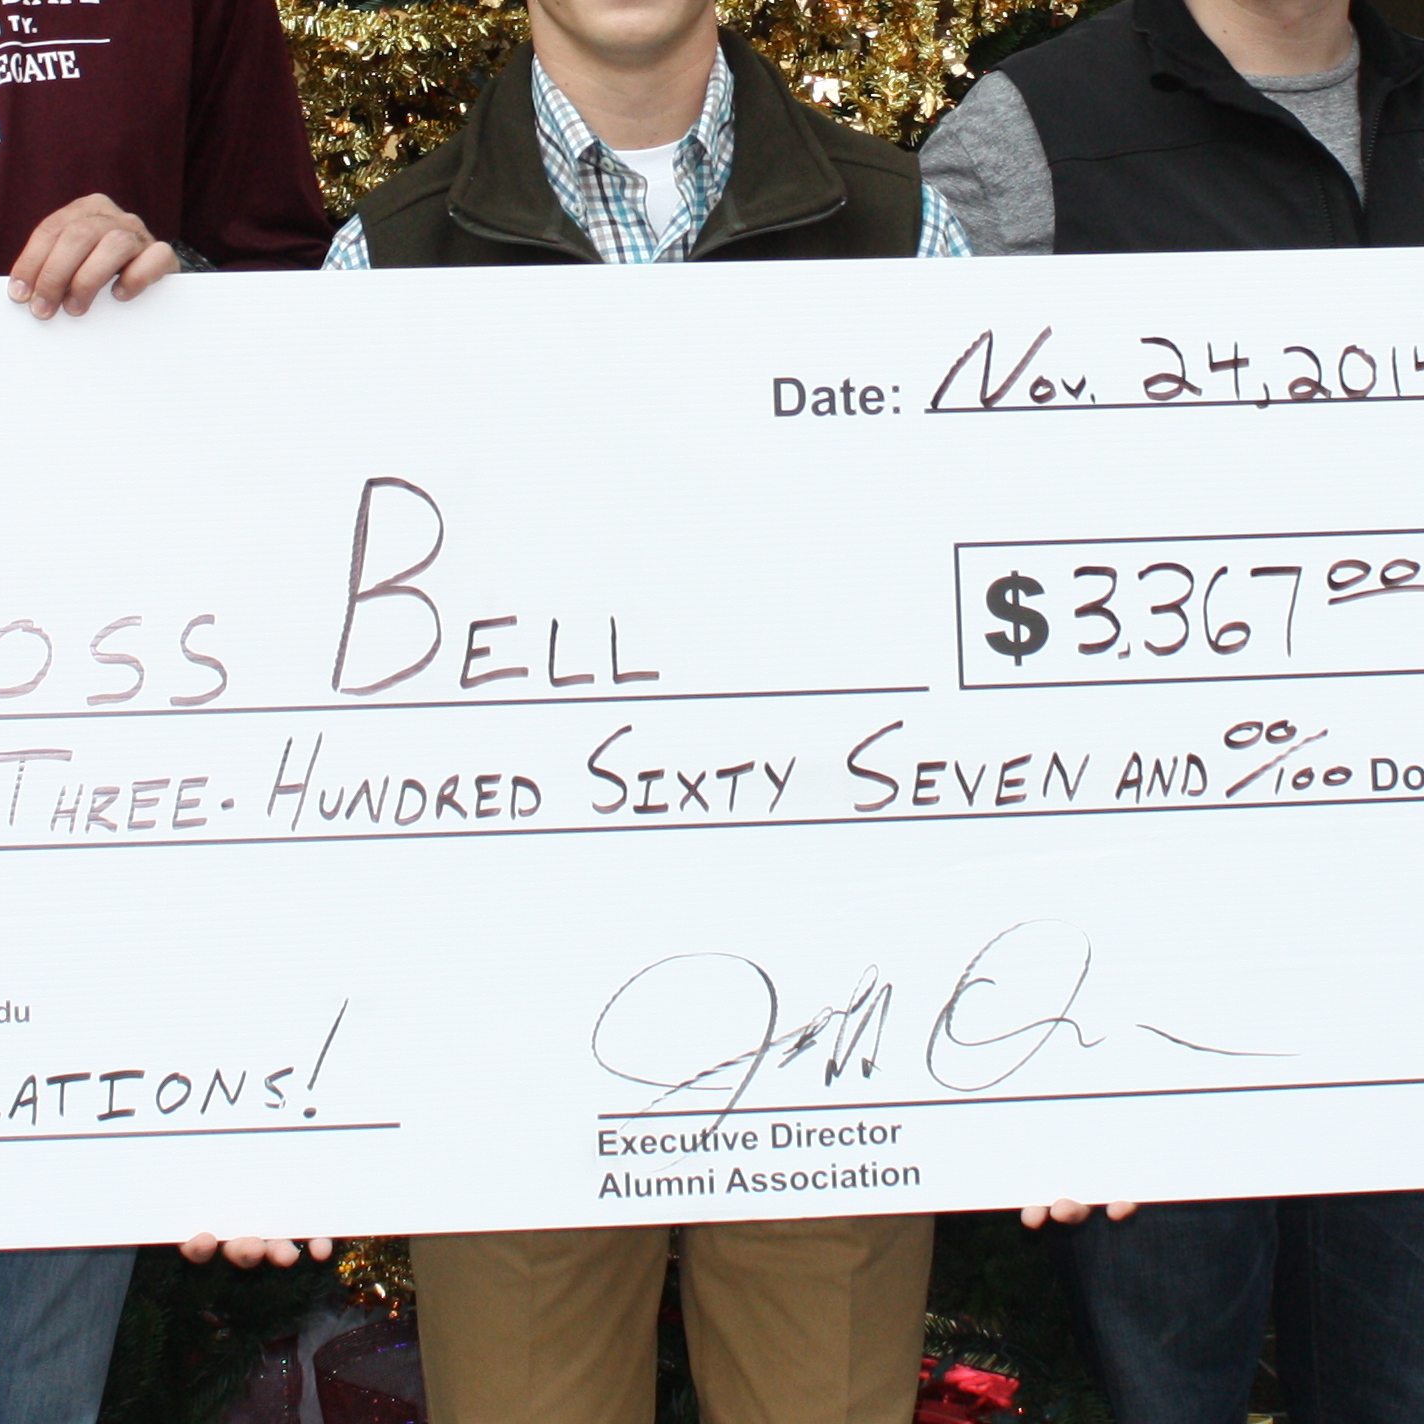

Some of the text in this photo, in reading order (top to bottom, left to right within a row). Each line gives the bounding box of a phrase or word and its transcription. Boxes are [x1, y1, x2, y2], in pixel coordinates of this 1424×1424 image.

[931, 325, 1097, 408] Nov.
[772, 377, 902, 419] Date:
[332, 476, 664, 698] BELL
[587, 724, 796, 813] SIXTY
[846, 719, 1091, 812] SEVEN
[1114, 751, 1208, 803] AND
[598, 1122, 903, 1156] Executive Director
[598, 1164, 921, 1200] Alumni Association
